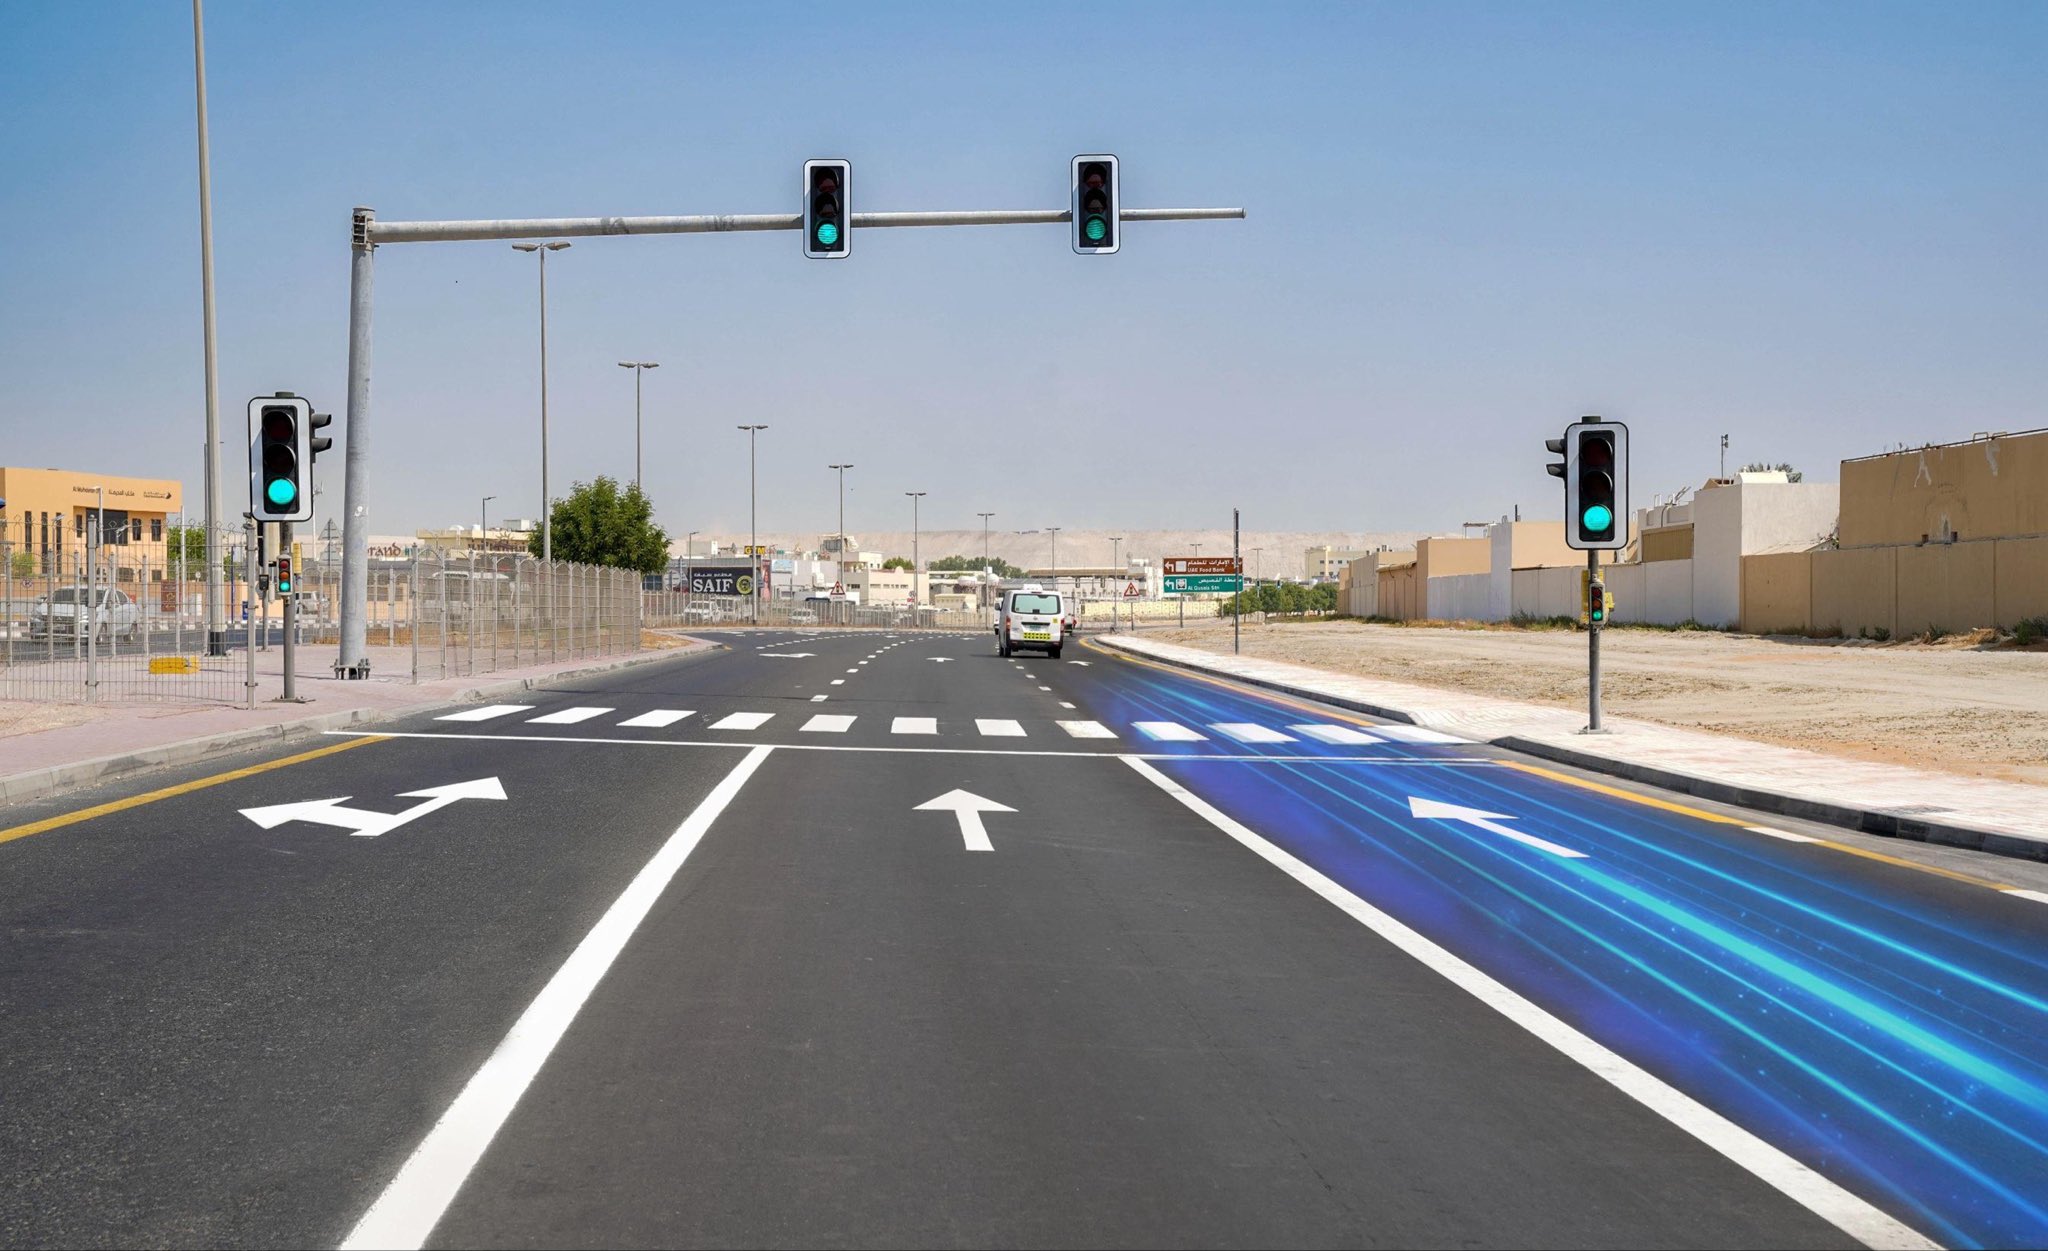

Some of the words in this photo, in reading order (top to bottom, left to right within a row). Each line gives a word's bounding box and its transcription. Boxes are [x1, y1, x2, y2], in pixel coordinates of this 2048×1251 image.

[368, 542, 402, 557] rand
[745, 547, 765, 555] GM
[693, 578, 733, 593] SAIF
